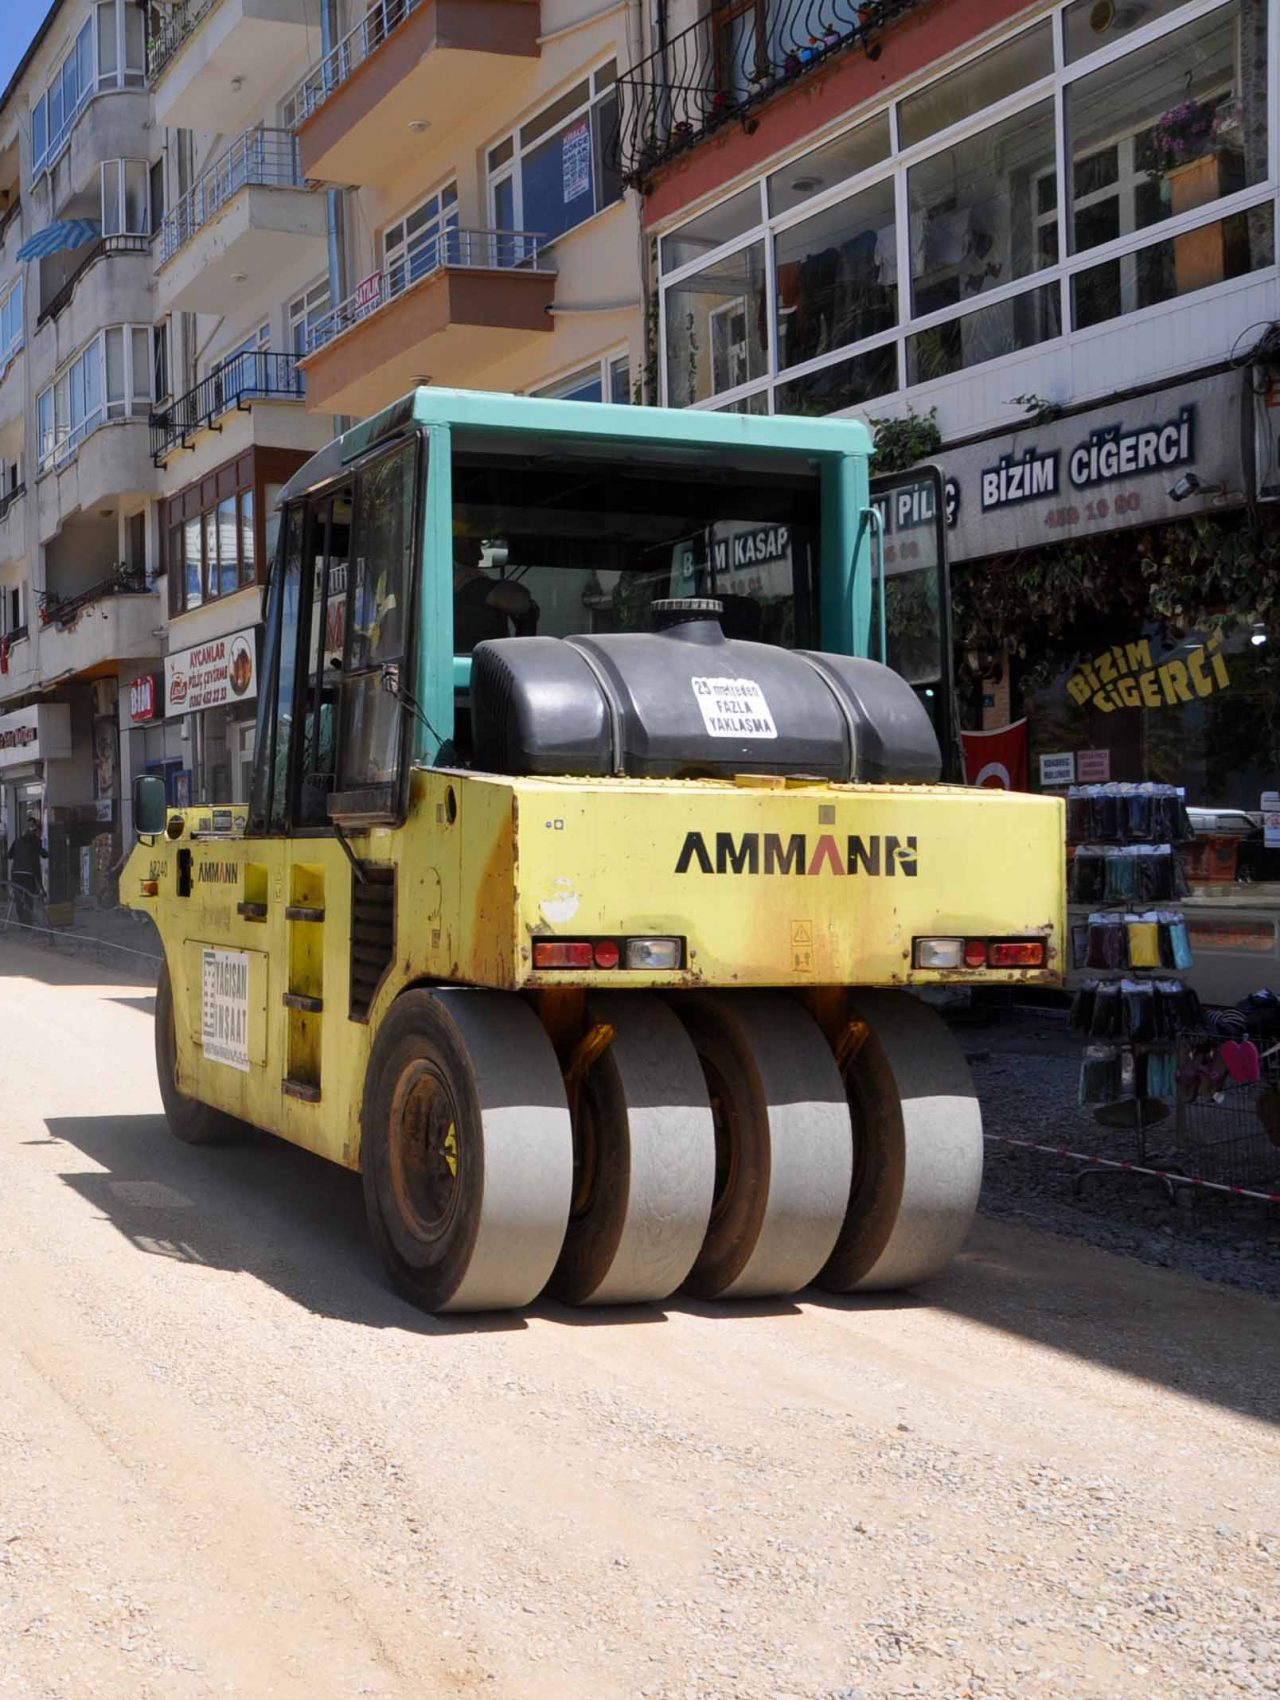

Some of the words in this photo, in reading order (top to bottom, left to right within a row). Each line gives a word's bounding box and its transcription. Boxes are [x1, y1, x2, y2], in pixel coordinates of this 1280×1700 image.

[982, 453, 1055, 507] BİZİM
[1070, 411, 1190, 485] CİĞERCİ
[898, 480, 956, 524] PİLÇ
[734, 526, 789, 568] KASAP
[189, 642, 225, 669] AYCANLAR
[130, 677, 151, 715] BİM
[694, 680, 712, 695] 25
[716, 700, 753, 714] FAZLA
[708, 716, 773, 735] YAKLAŞMA
[673, 831, 918, 877] AMMANN
[198, 861, 238, 884] AMMANN
